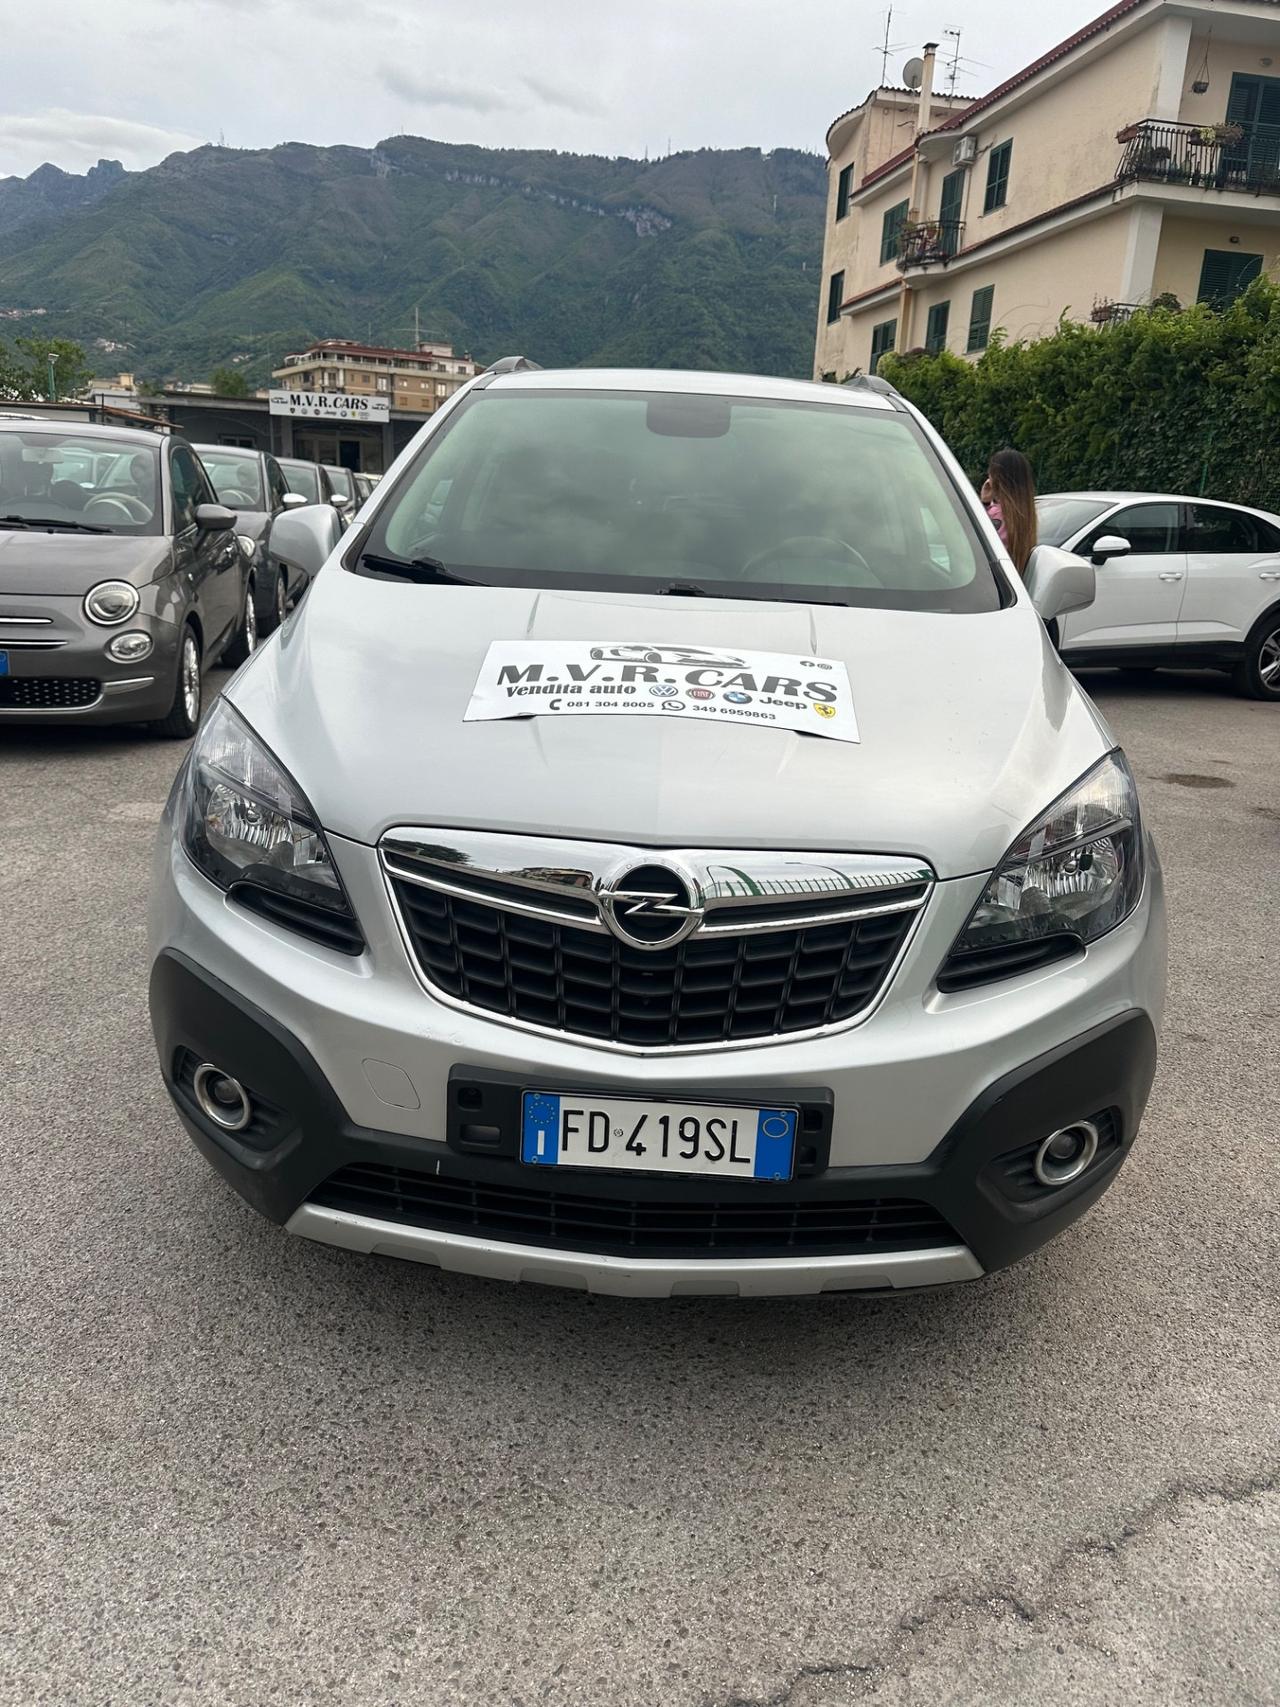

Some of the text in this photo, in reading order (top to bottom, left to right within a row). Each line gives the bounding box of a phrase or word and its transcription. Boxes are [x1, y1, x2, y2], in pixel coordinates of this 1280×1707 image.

[589, 684, 636, 694] auto
[759, 697, 807, 709] Jeep
[693, 705, 717, 713] 349
[720, 708, 776, 720] 6959863
